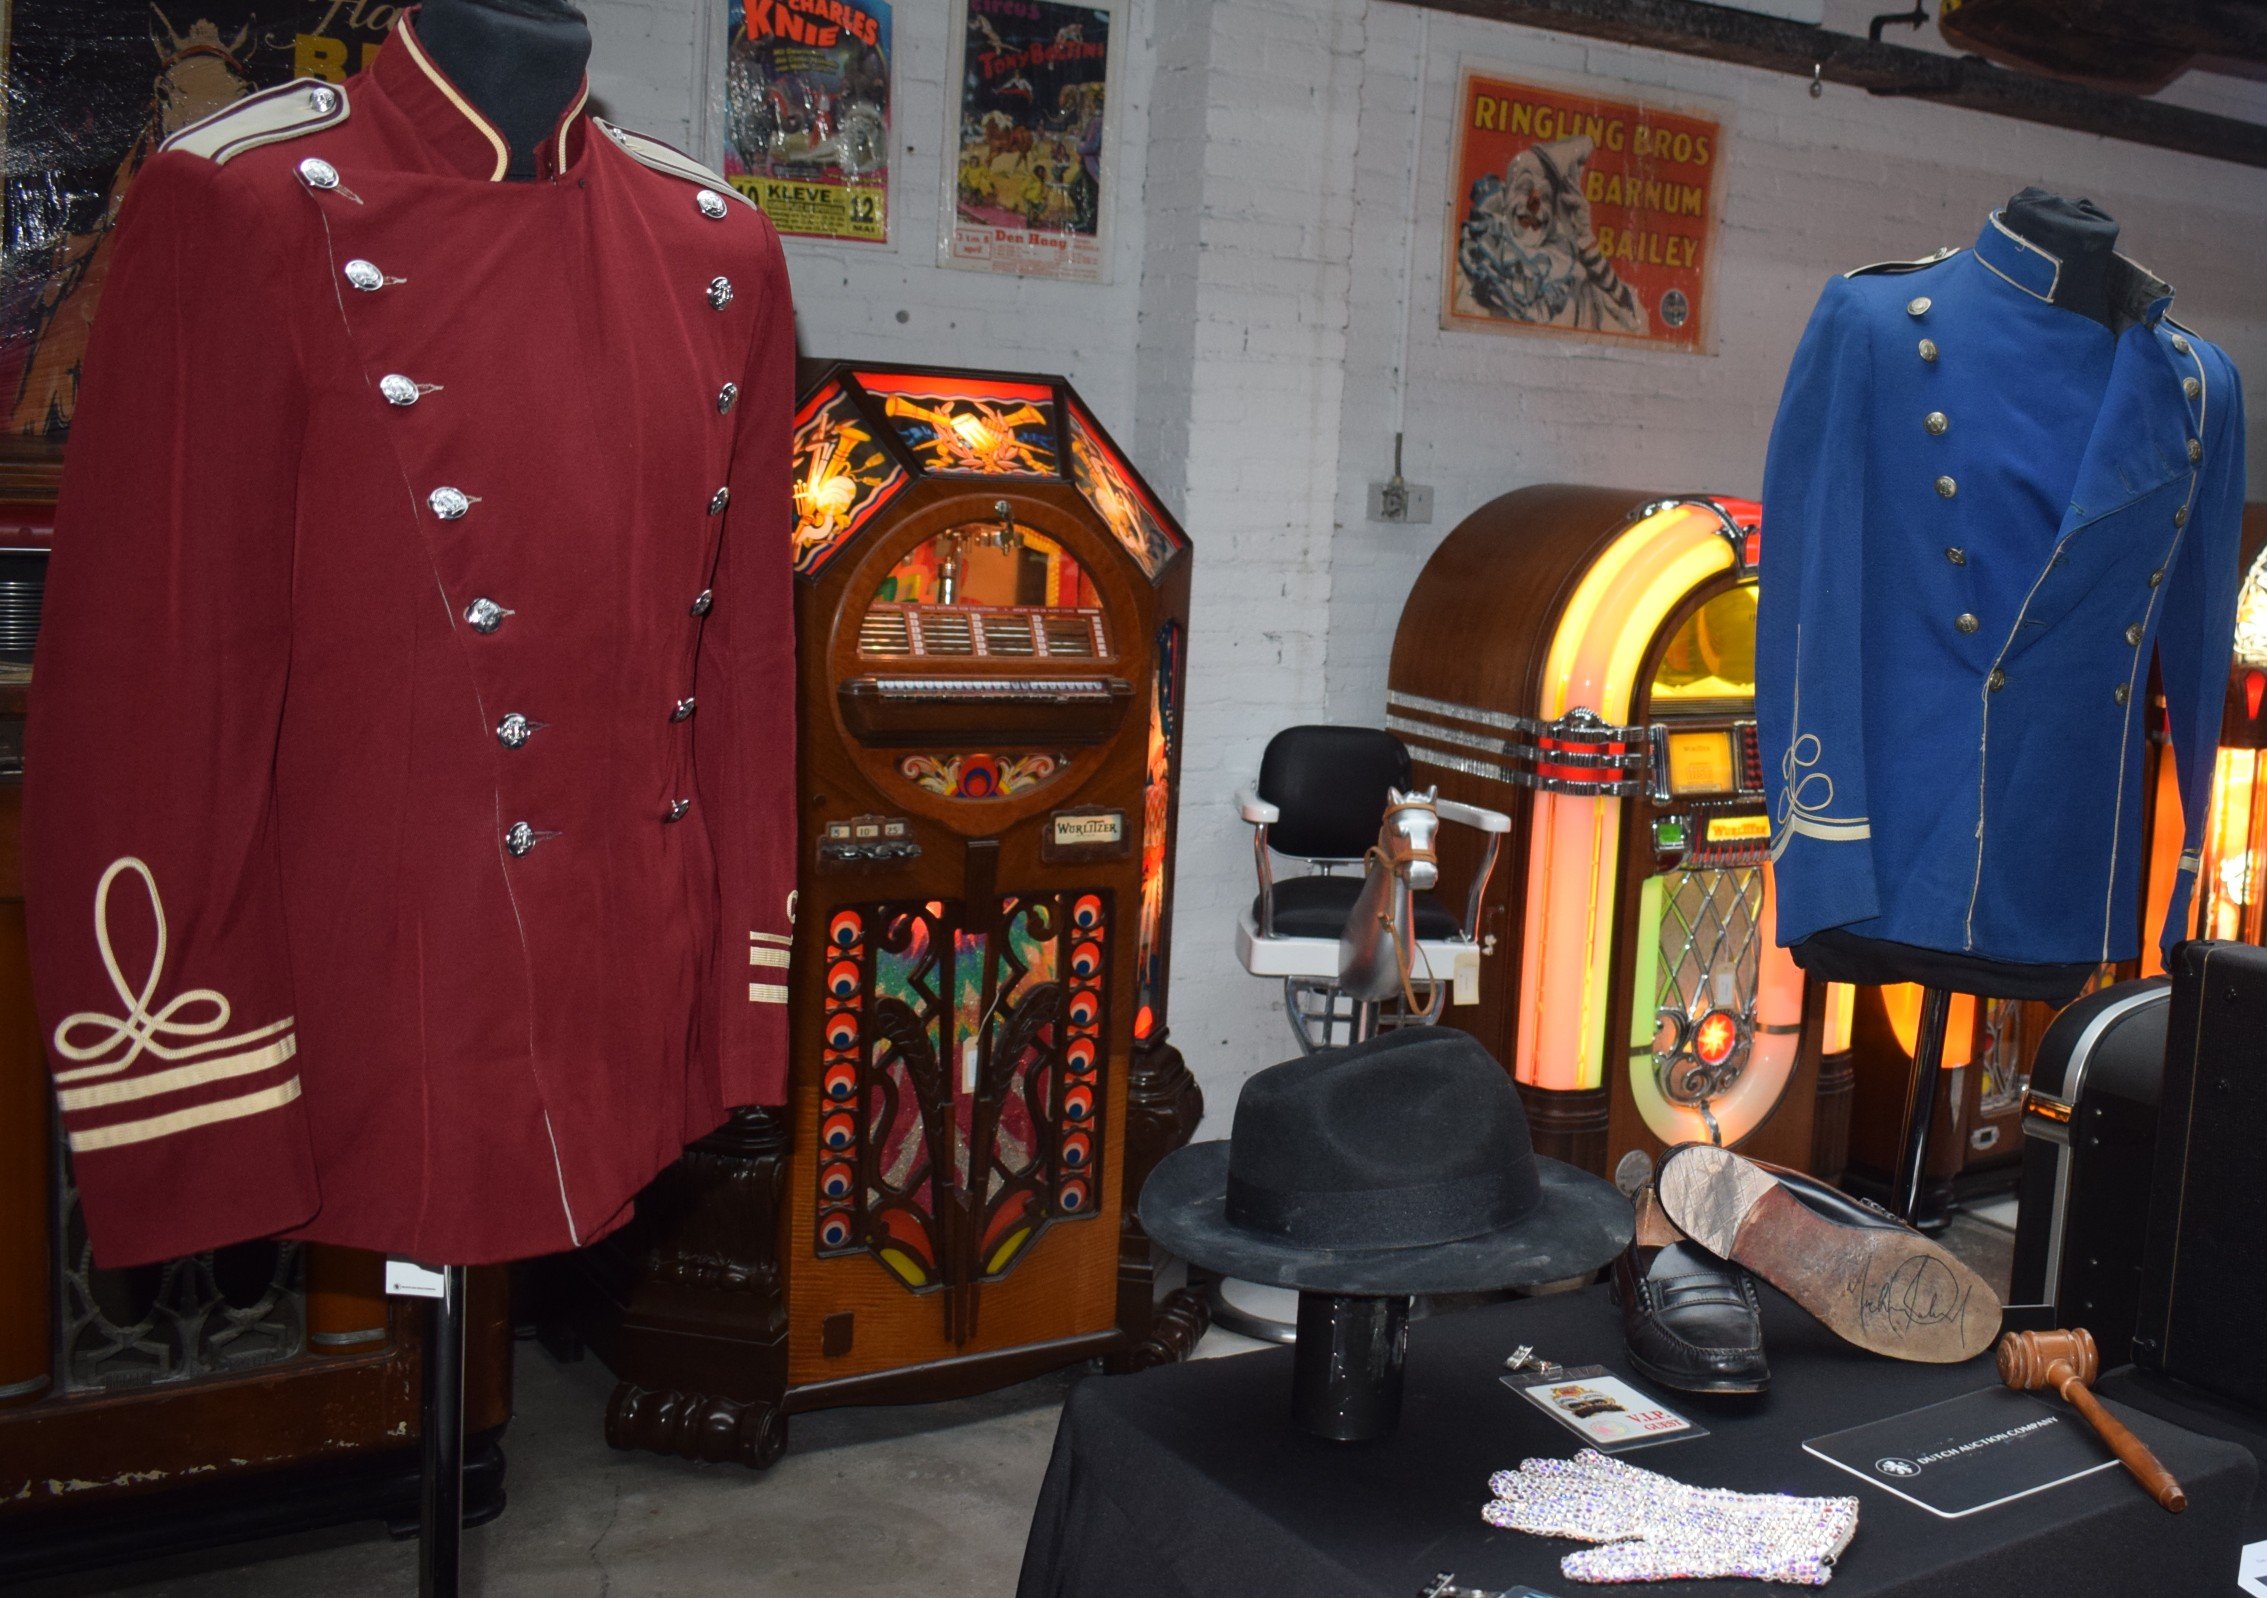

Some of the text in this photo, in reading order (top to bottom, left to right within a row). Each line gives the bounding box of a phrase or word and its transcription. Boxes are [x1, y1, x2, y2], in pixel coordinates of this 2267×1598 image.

[744, 0, 839, 46] KNIE
[1474, 95, 1710, 166] RINGLING BROS
[767, 184, 832, 203] KLEVE
[1586, 170, 1702, 217] BARNUM
[850, 195, 874, 223] 12
[994, 229, 1068, 251] Den Haag
[1598, 226, 1698, 268] BAILEY
[1057, 819, 1117, 835] WURLITZER
[1625, 1409, 1672, 1425] V.I.P.
[1643, 1418, 1683, 1432] GUEST
[1916, 1415, 2059, 1465] DUTCH AUCTION COMPANY
